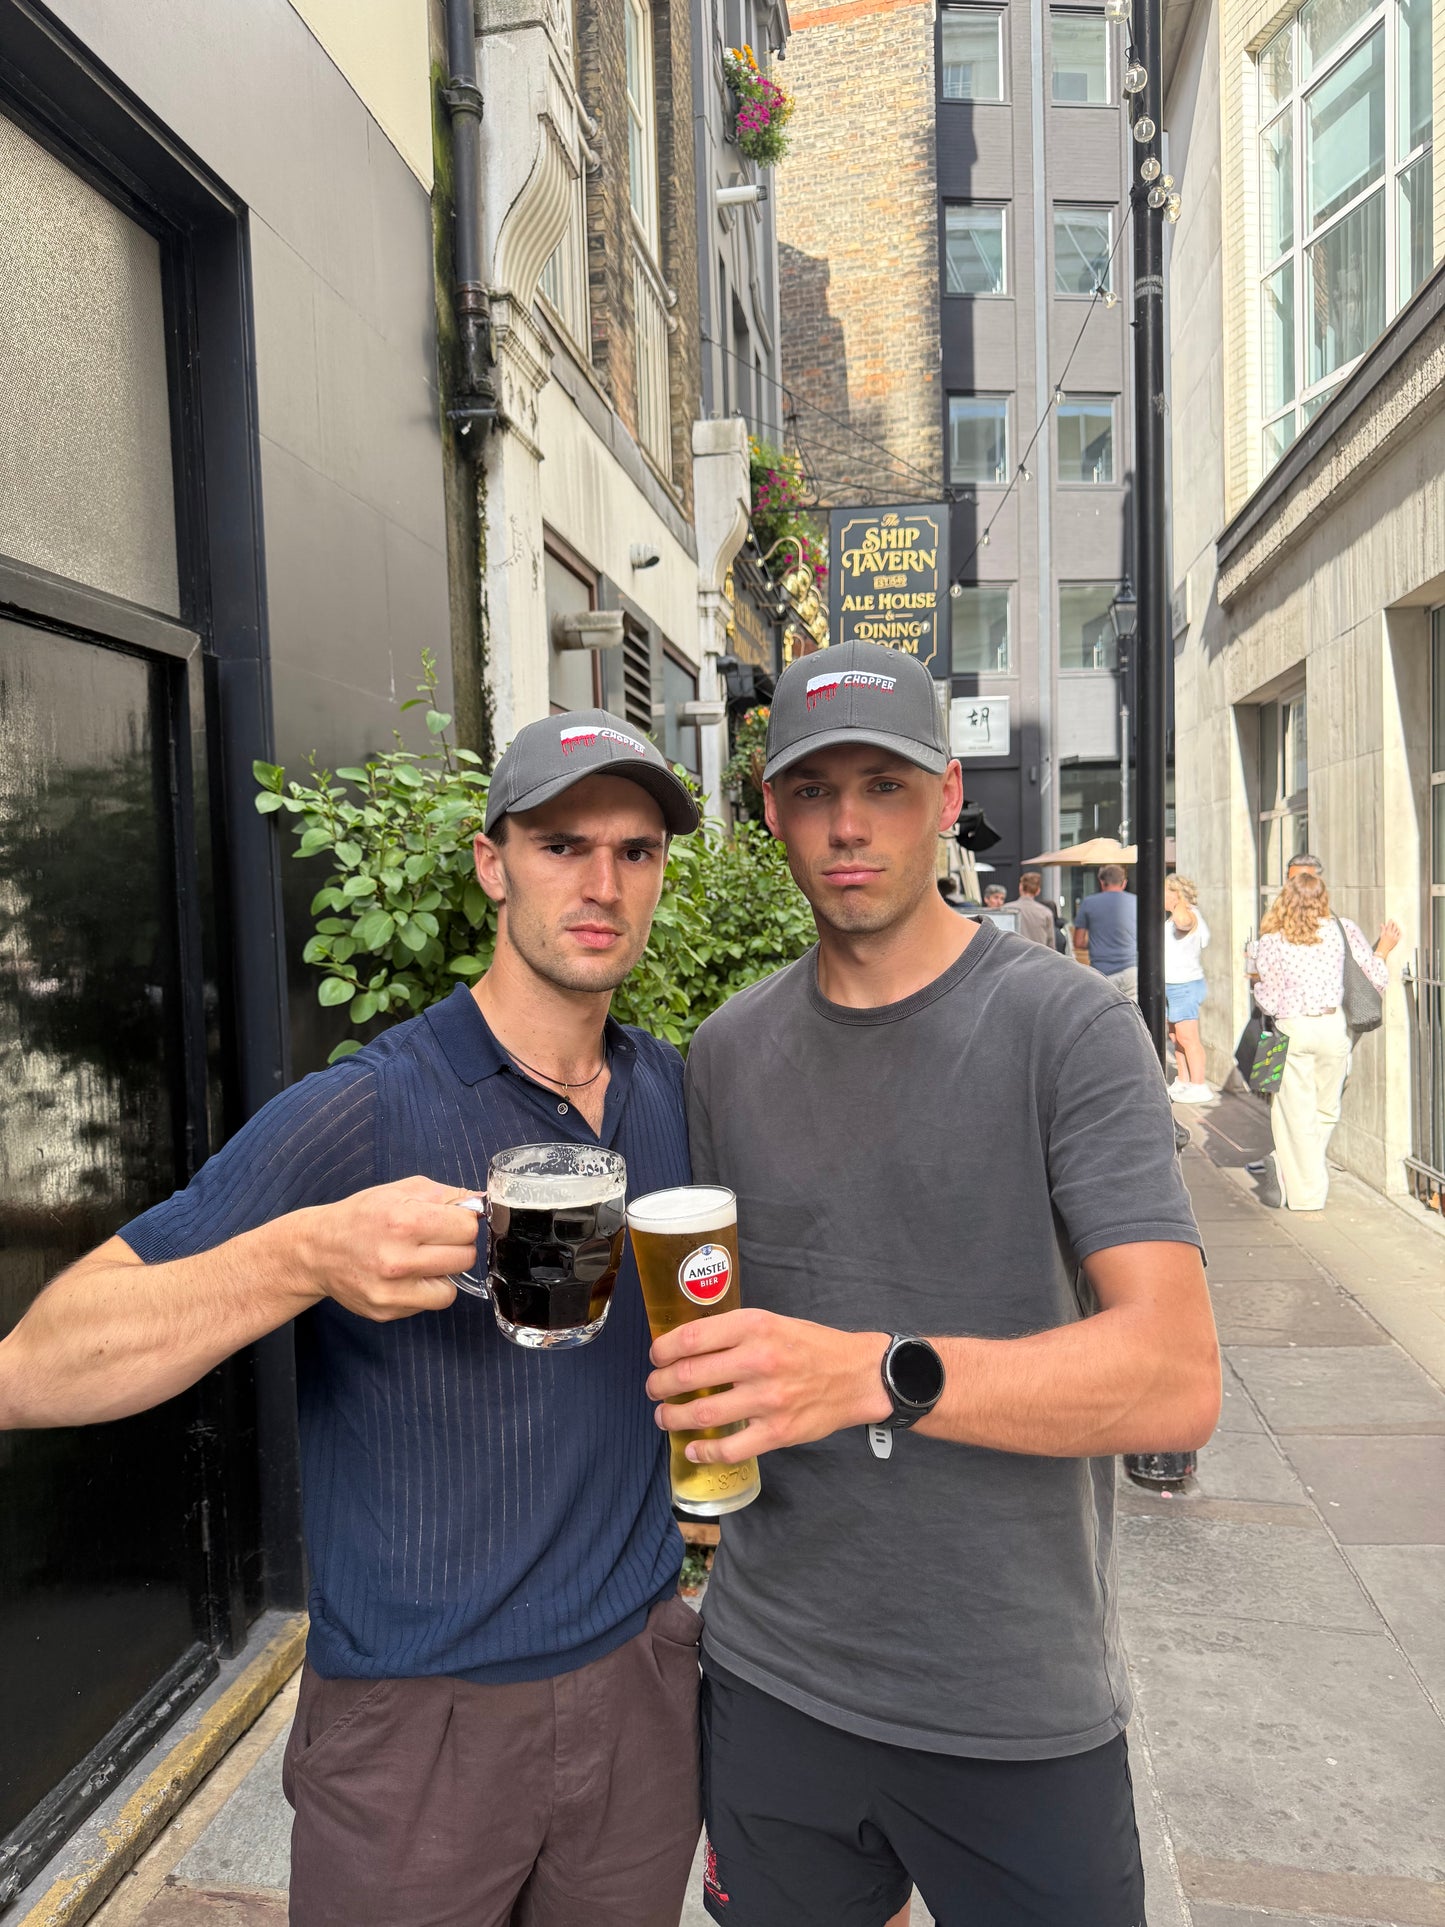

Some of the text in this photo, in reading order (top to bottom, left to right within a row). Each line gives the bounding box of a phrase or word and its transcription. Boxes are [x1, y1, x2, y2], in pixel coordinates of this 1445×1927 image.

[882, 514, 899, 527] The
[862, 527, 920, 553] SHIP
[841, 549, 937, 577] TAVERN
[841, 592, 937, 612] ALE HOUSE
[885, 610, 895, 621] &
[854, 621, 922, 639] DINING
[868, 638, 919, 654] OM
[844, 675, 894, 689] CHOPPER
[602, 731, 644, 753] CHOPPER
[688, 1261, 726, 1279] AMSTEL
[700, 1276, 719, 1288] BIER
[706, 1465, 749, 1492] 1870
